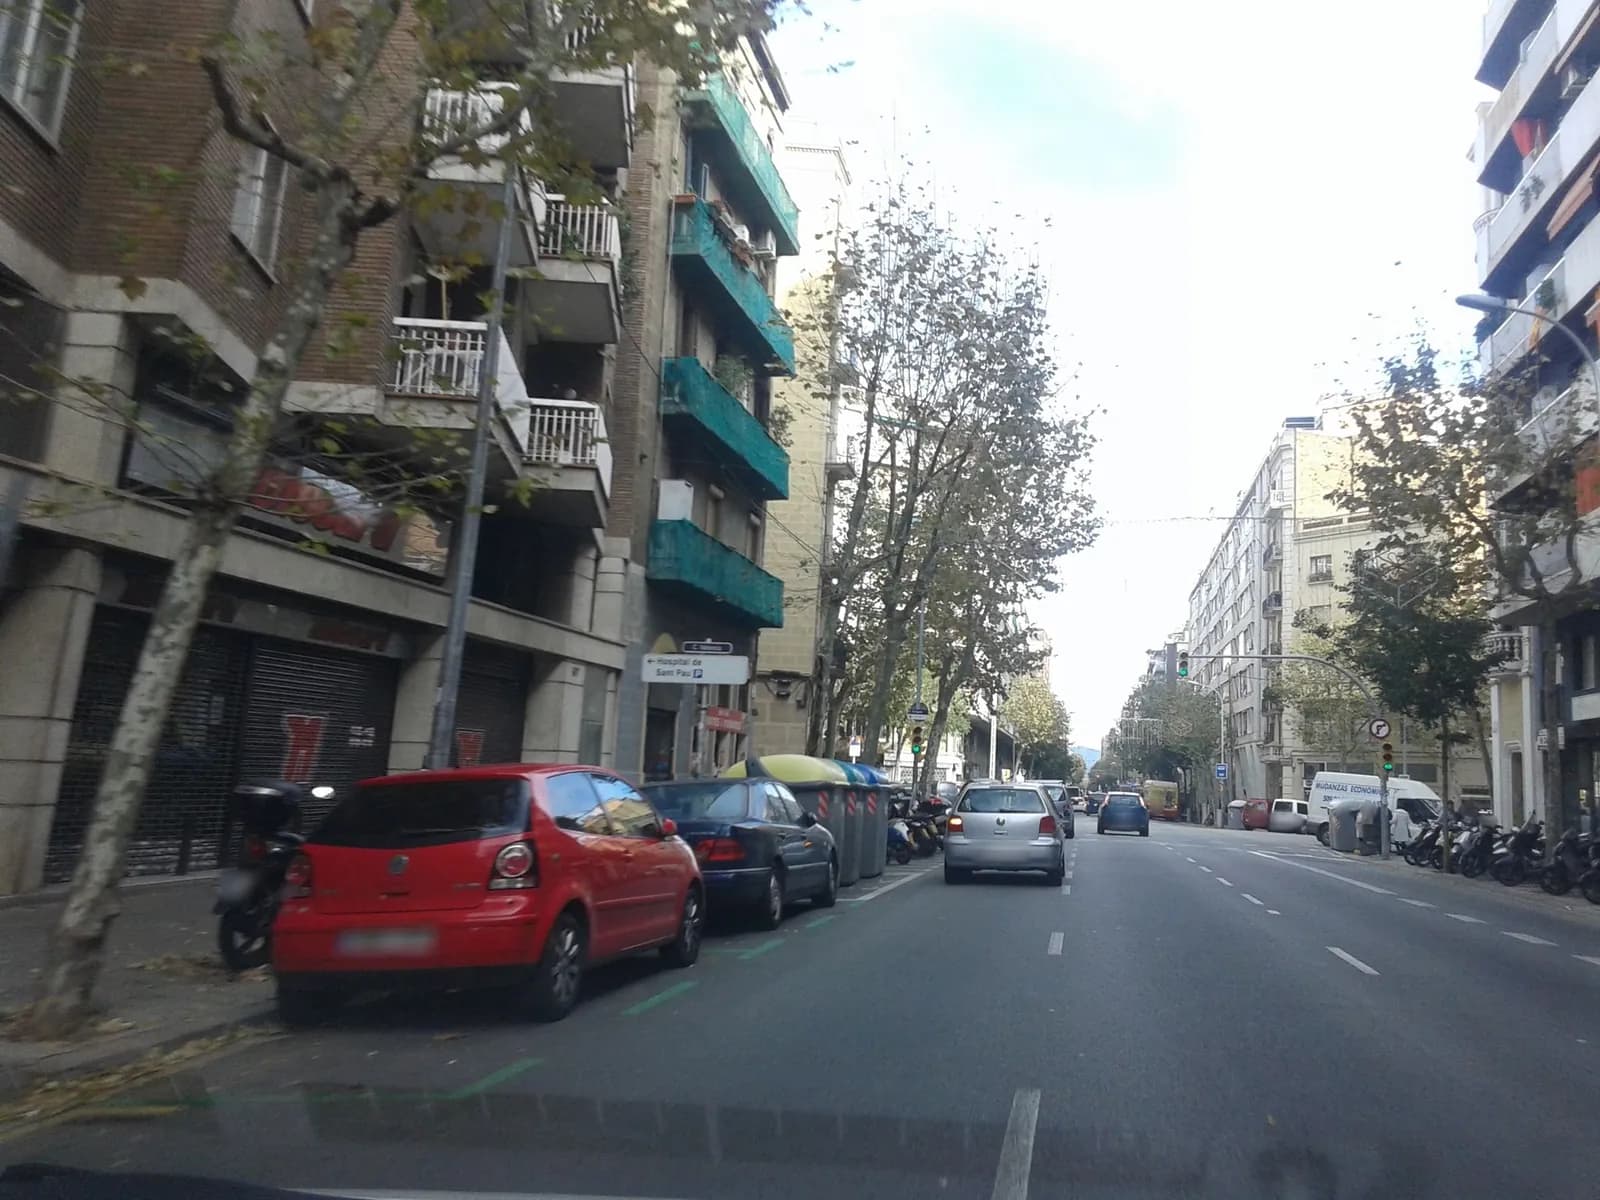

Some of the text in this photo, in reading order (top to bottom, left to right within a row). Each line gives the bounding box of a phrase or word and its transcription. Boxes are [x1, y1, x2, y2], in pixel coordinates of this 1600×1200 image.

[656, 658, 702, 667] Hospital de
[656, 668, 673, 676] Sant
[676, 669, 691, 677] Pau
[1316, 782, 1347, 792] MUDANZAS
